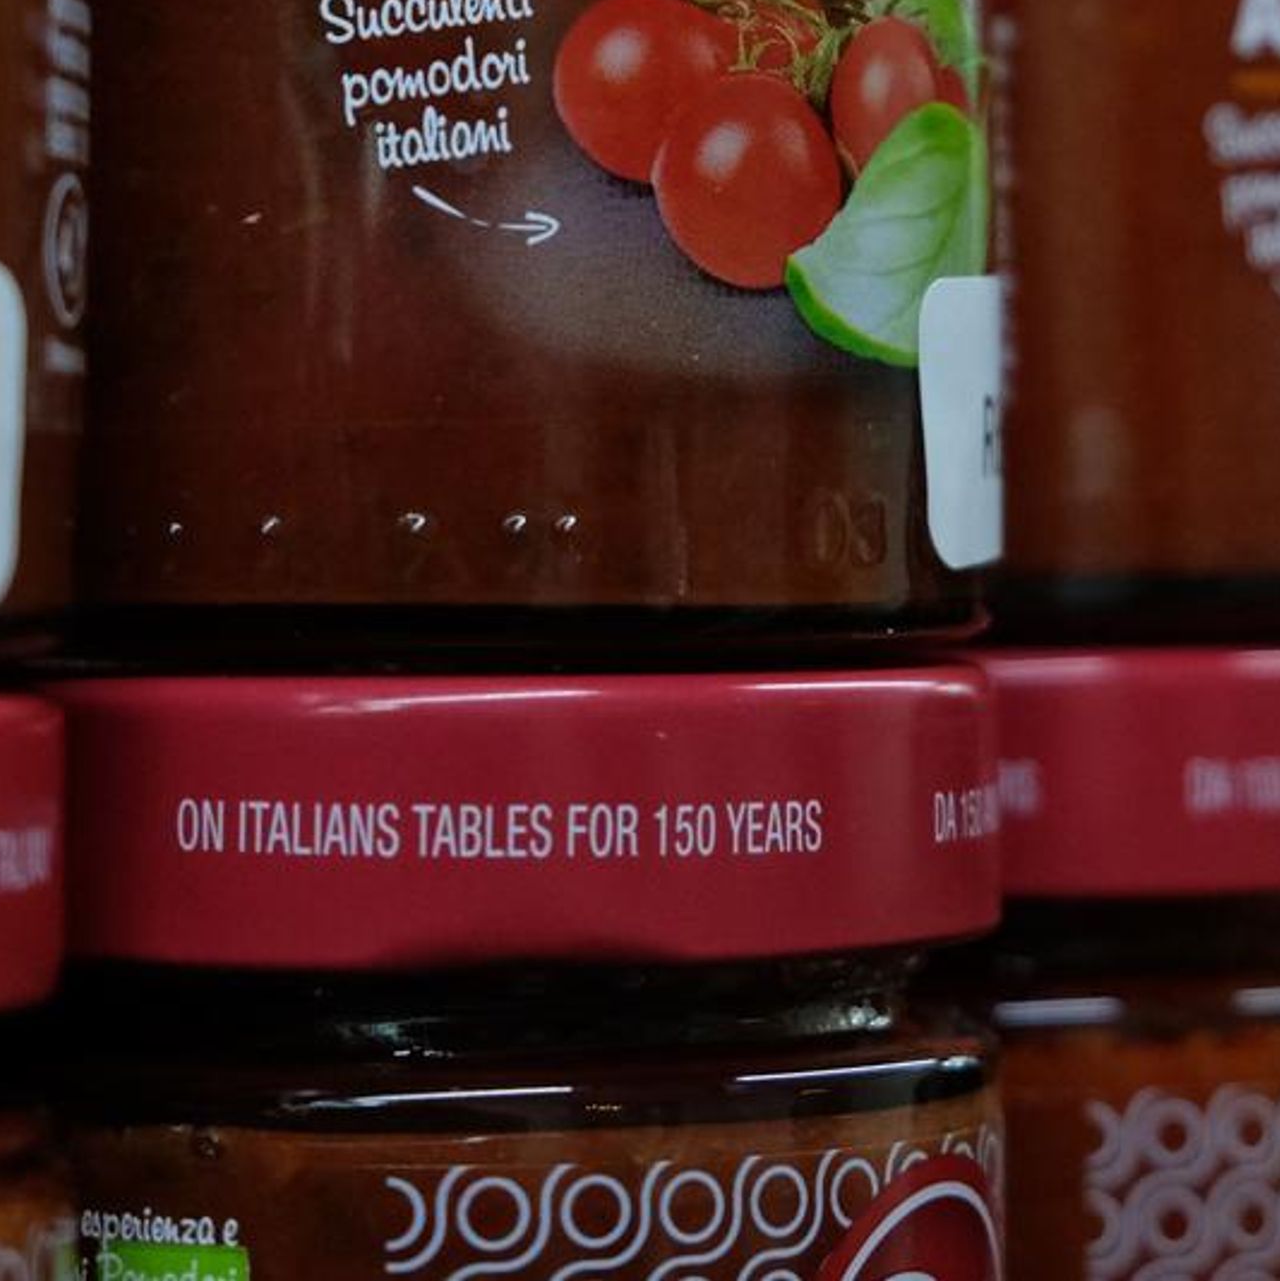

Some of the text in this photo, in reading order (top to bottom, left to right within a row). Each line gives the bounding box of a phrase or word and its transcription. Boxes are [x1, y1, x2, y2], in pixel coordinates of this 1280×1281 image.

[341, 35, 531, 127] pomodori
[375, 105, 513, 169] italiani
[176, 798, 822, 858] ON ITALIANS TABLES FOR 150 YEARS
[80, 1206, 239, 1253] esperienza e
